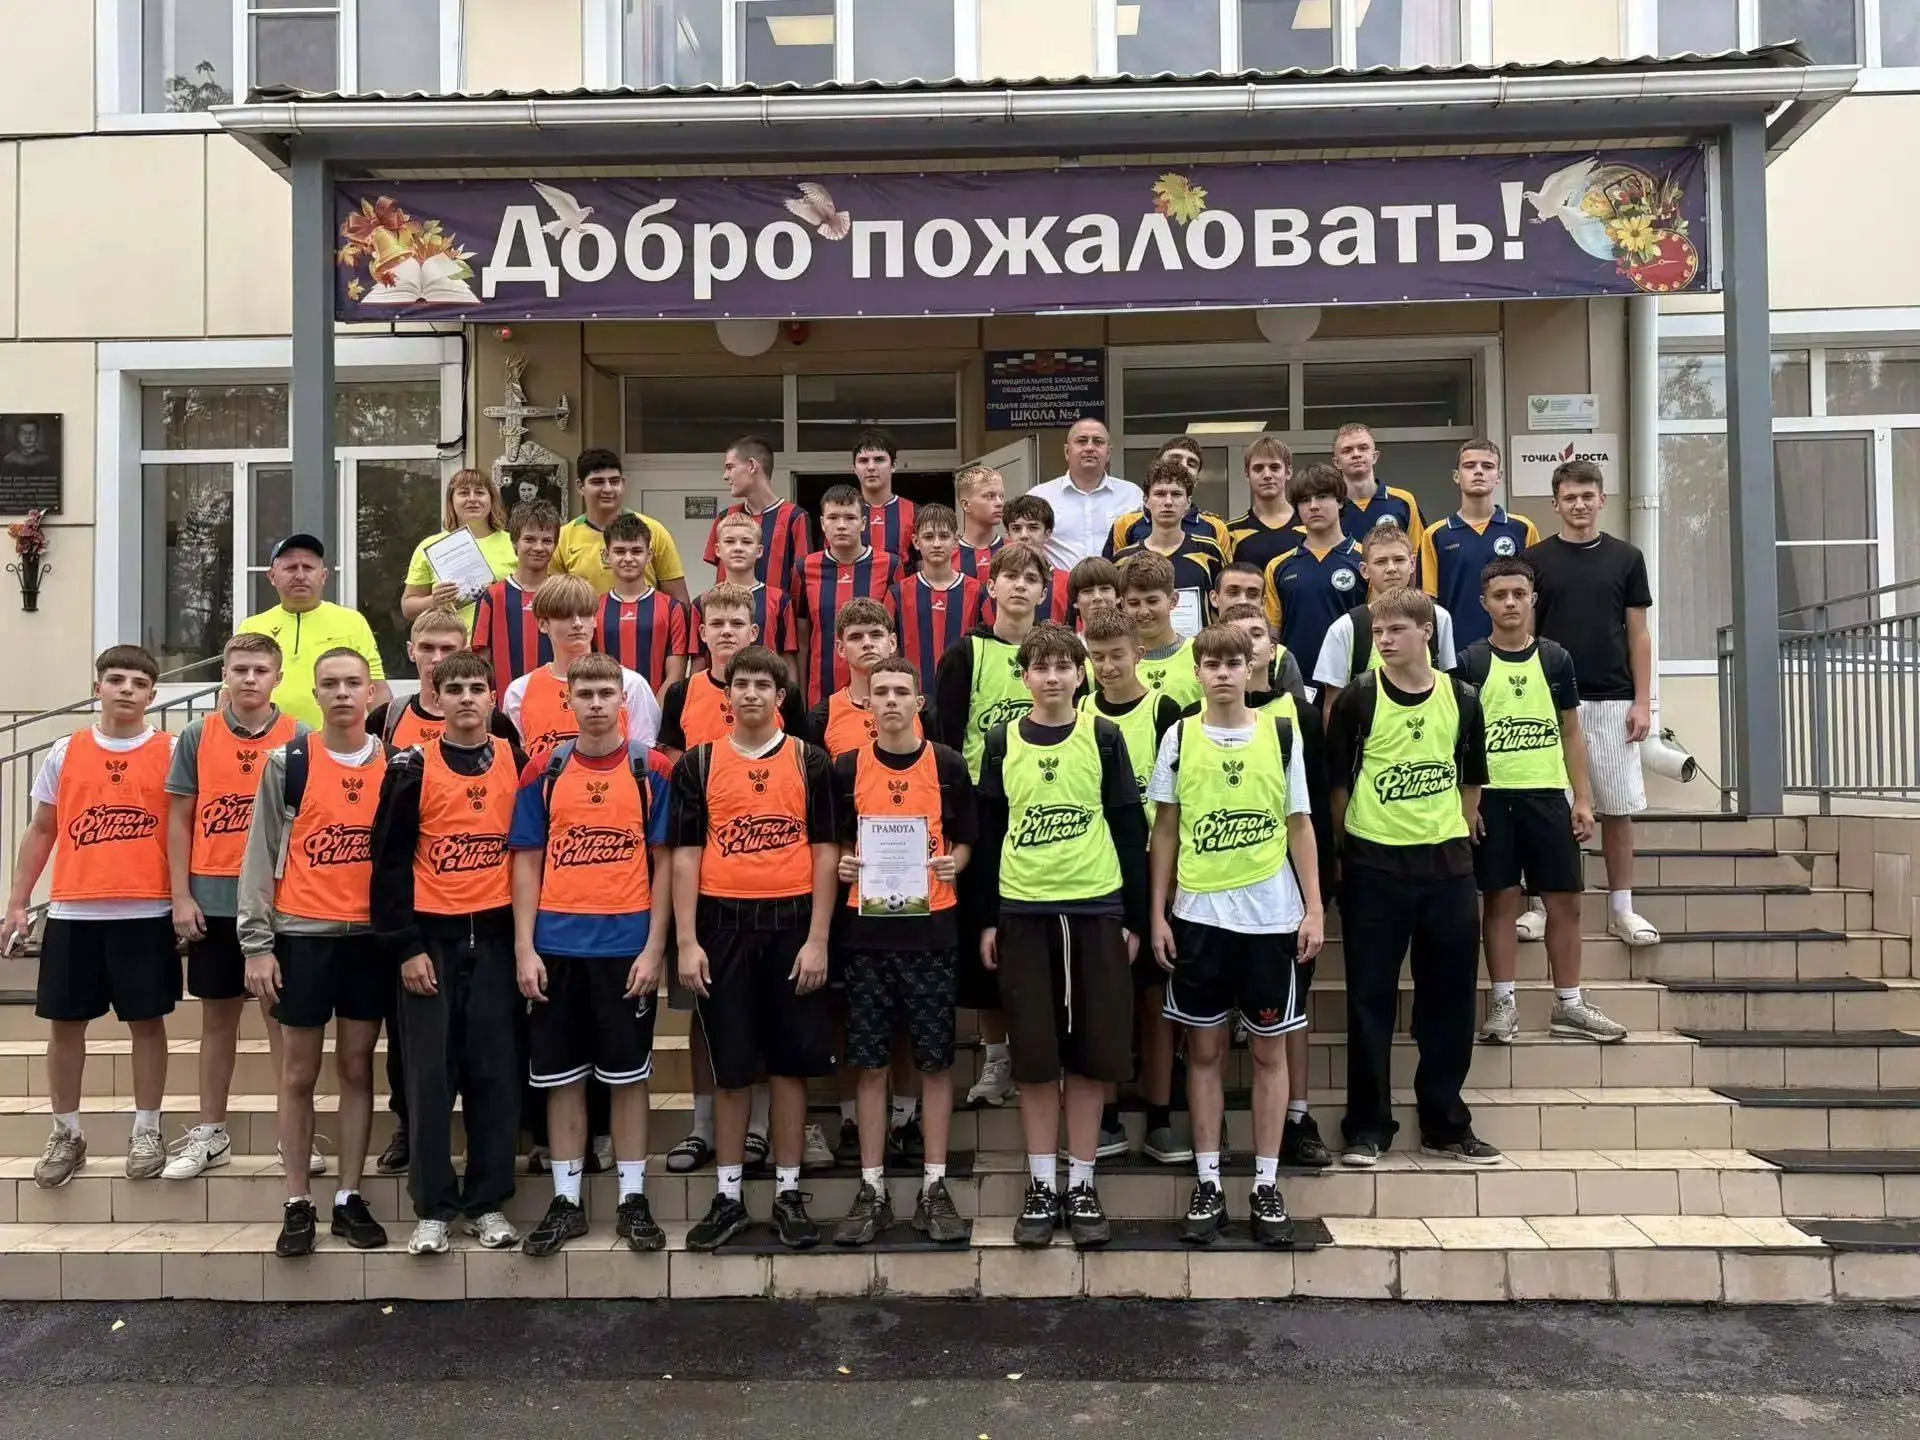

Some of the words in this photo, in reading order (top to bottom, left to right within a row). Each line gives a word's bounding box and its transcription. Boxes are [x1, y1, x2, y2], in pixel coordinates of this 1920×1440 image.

[481, 199, 813, 299] Добро
[852, 181, 1526, 278] пожаловать!
[1010, 410, 1056, 420] ШКОЛА
[1059, 409, 1080, 420] №4
[1521, 454, 1557, 462] ТОЧКА
[1575, 453, 1609, 461] РОСТА
[872, 824, 915, 833] ГРАМОТА
[305, 829, 370, 866] ФУТБО
